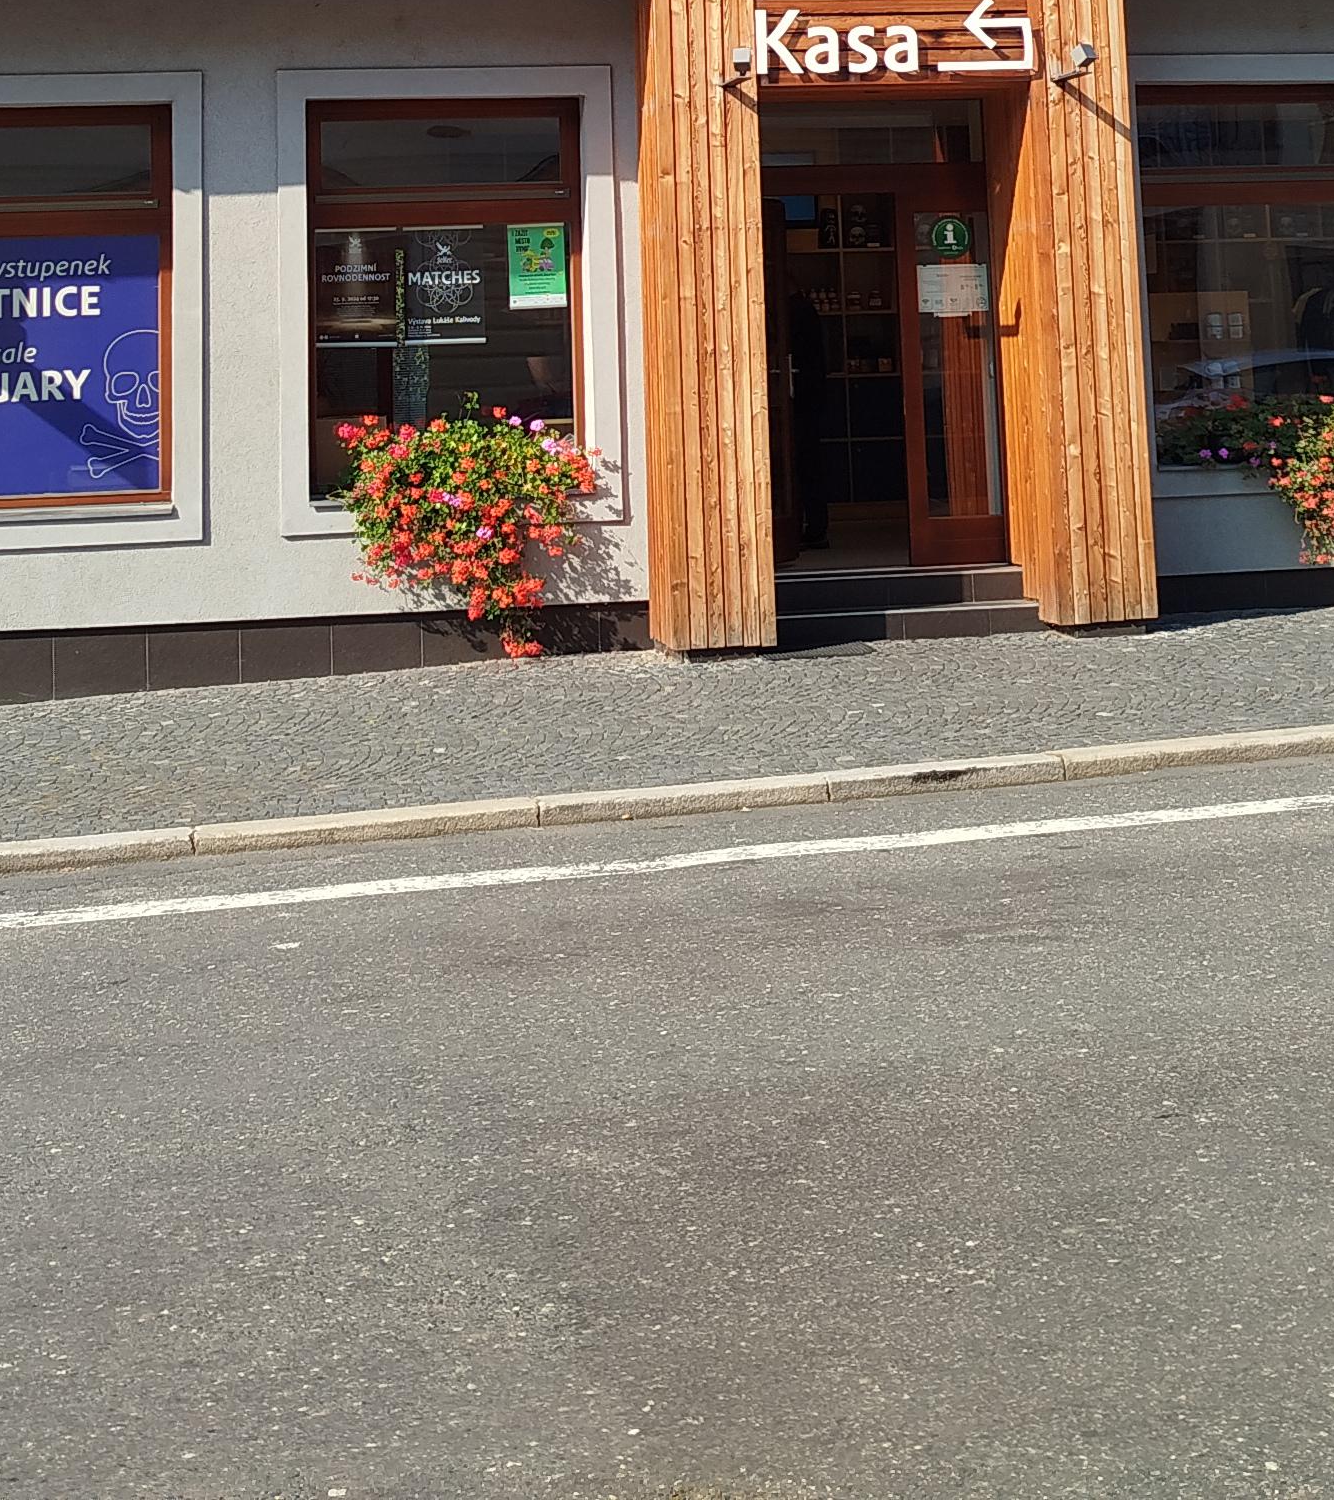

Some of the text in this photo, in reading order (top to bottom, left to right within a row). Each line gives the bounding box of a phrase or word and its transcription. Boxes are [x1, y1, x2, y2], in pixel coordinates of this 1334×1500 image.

[754, 8, 920, 75] Kasa
[334, 262, 378, 273] PODZIMNÍ
[321, 272, 392, 283] ROVNODENNOST
[408, 269, 481, 286] MATCHES
